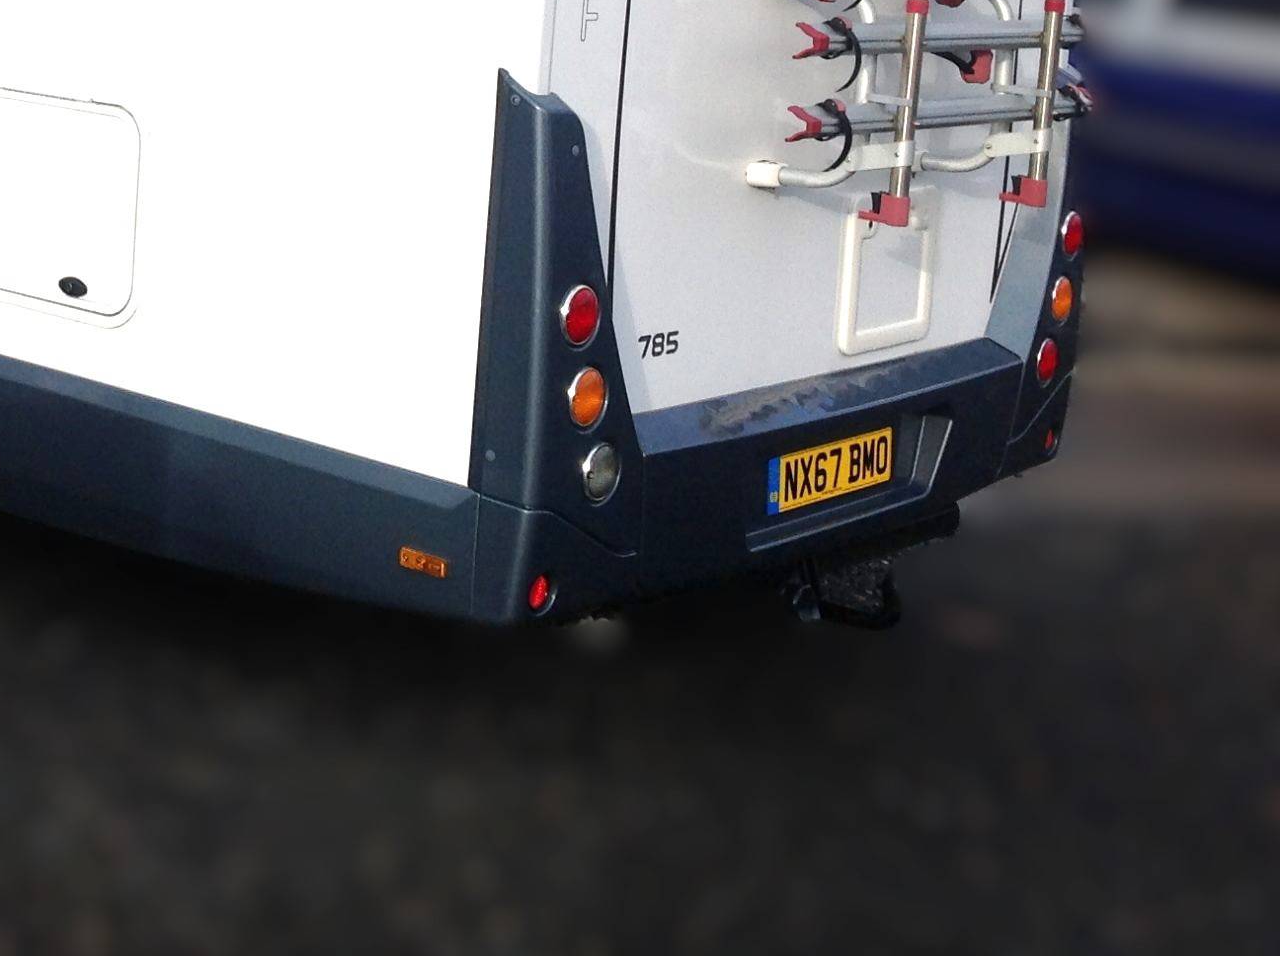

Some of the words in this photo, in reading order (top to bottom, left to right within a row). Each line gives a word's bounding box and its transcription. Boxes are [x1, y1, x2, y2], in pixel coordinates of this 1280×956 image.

[638, 330, 679, 360] 785
[784, 447, 842, 503] NX67
[848, 435, 889, 484] BMO
